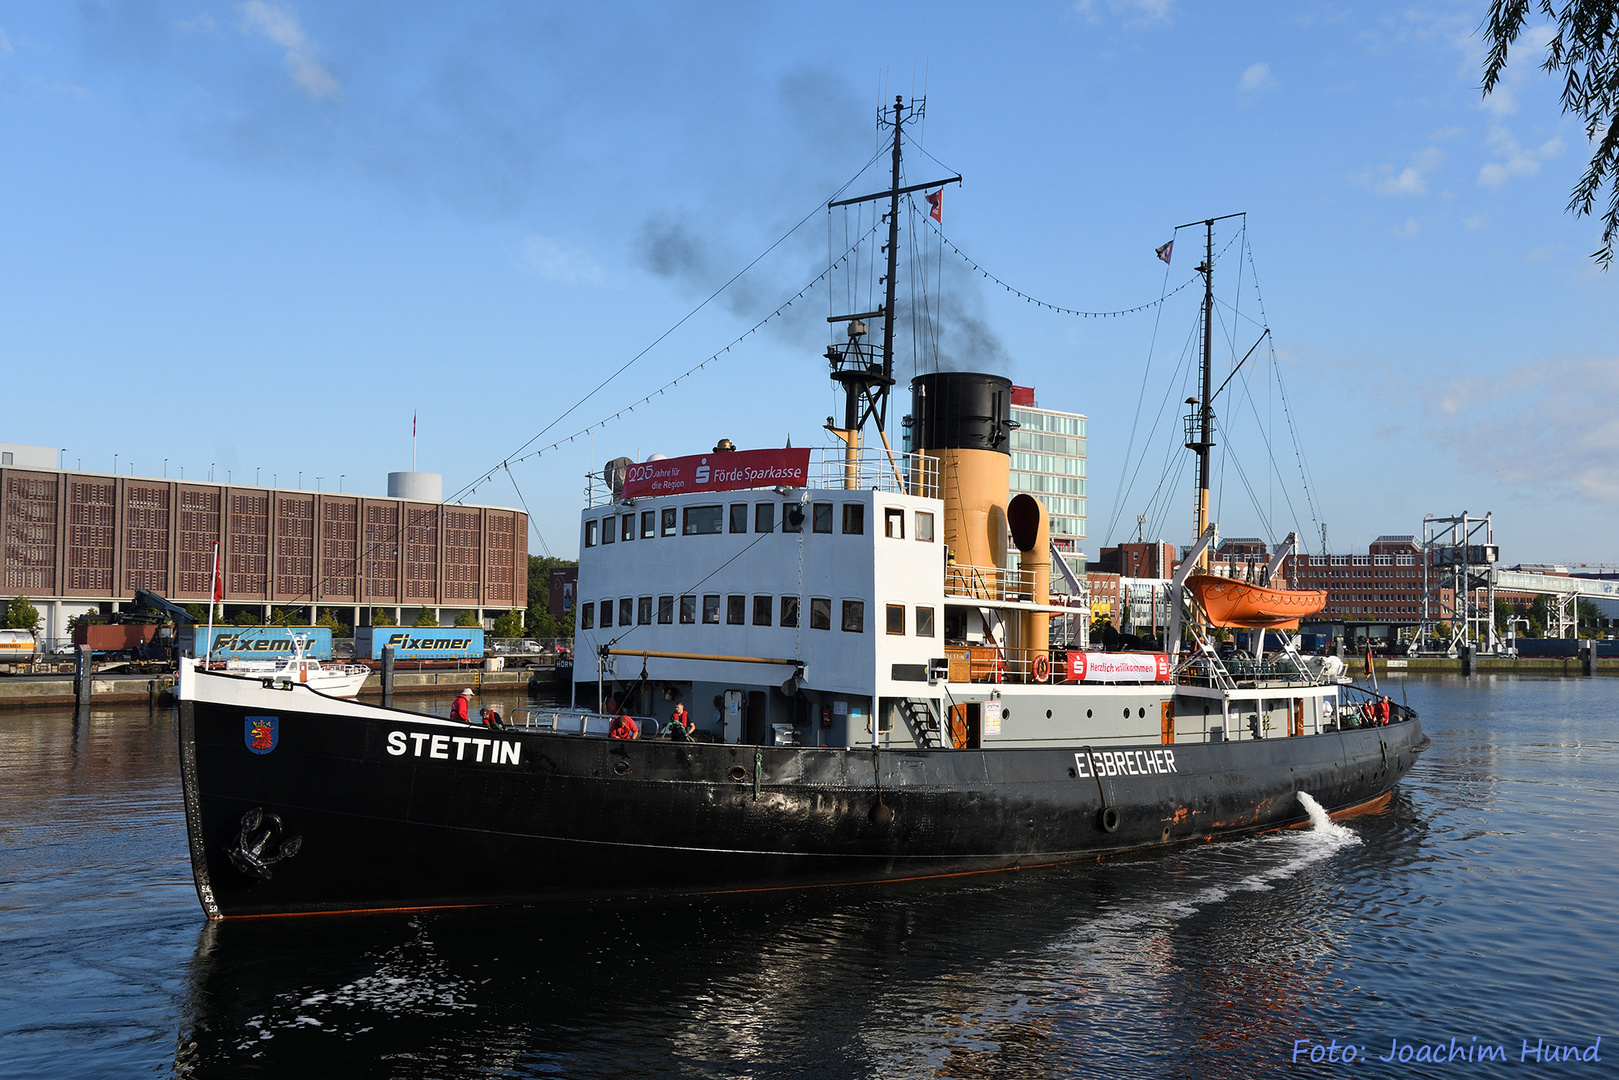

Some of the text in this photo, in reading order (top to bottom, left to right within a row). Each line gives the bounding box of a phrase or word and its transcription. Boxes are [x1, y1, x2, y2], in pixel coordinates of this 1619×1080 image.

[628, 464, 680, 482] 225 Jahre für
[713, 465, 802, 483] Förde Sparkasse
[651, 480, 685, 491] die Region
[388, 633, 472, 650] Fixemer
[1089, 662, 1154, 673] Herzlich willkommen
[386, 731, 521, 765] STETTIN
[1074, 749, 1178, 778] EISBRECHER
